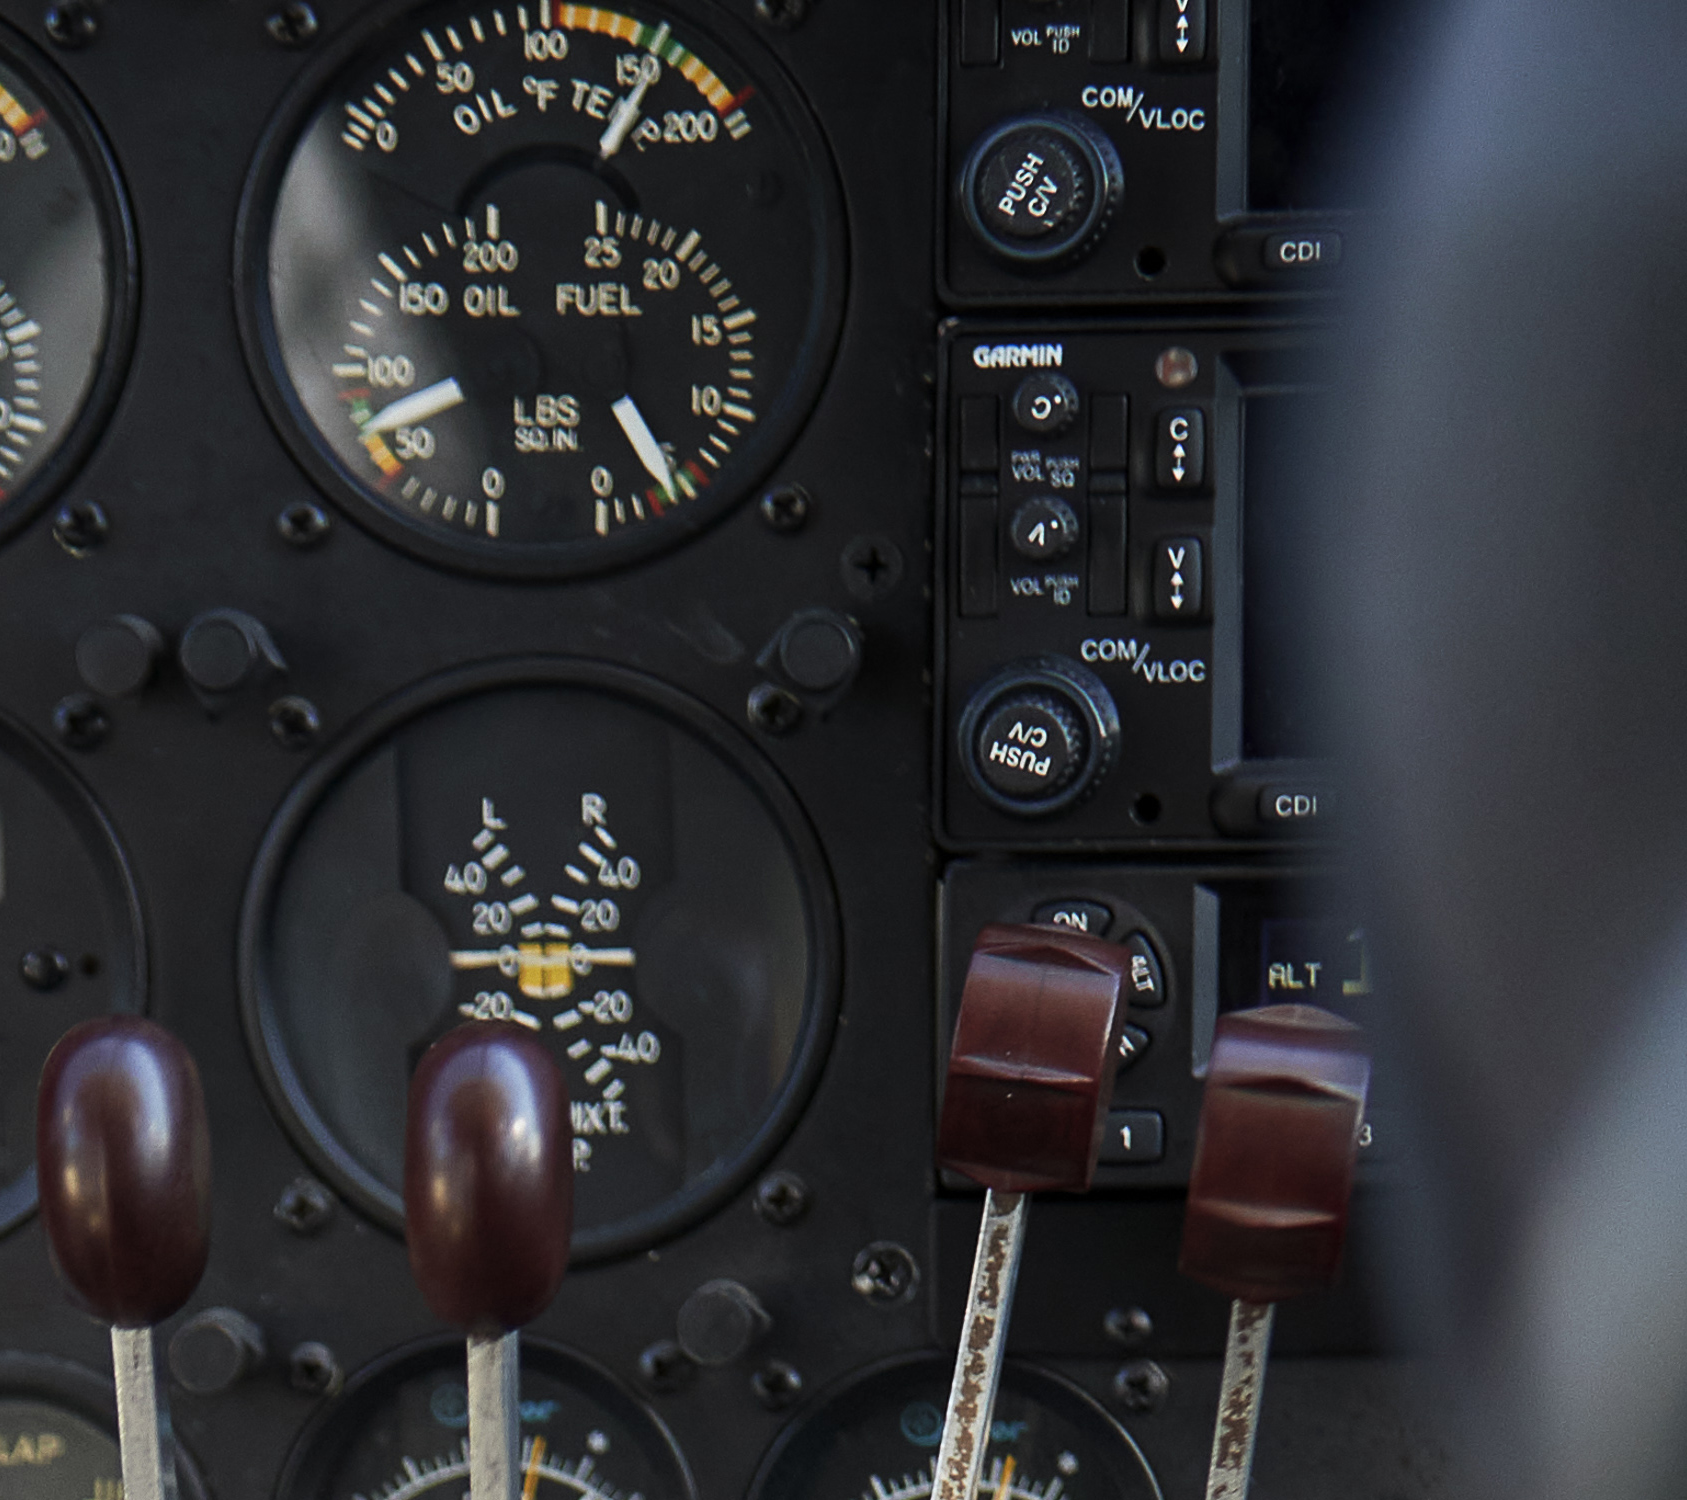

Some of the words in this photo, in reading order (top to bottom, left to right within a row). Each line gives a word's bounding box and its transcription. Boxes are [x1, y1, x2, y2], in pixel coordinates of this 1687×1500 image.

[524, 30, 568, 60] 100
[1012, 29, 1042, 46] VOL
[1046, 24, 1080, 38] PUSH
[1053, 39, 1069, 54] ID
[663, 111, 718, 143] 200
[998, 153, 1044, 216] PUSH
[1027, 176, 1058, 218] C/V
[463, 240, 518, 273] 200
[584, 237, 621, 269] 25
[1280, 240, 1321, 263] CDI
[643, 260, 680, 290] 20
[399, 283, 448, 315] 150
[463, 286, 521, 317] OIL
[556, 284, 641, 316] FUEL
[692, 316, 723, 347] 15
[973, 344, 1063, 369] GARMIN
[513, 395, 580, 427] LBS
[691, 385, 722, 415] 10
[1170, 417, 1189, 441] C
[1167, 547, 1185, 569] V
[1008, 722, 1048, 749] C/V
[989, 740, 1051, 777] PUSH
[482, 797, 507, 829] L
[582, 792, 607, 826] R
[1275, 795, 1317, 818] CDI
[598, 856, 641, 890] 40
[580, 899, 620, 934] 20
[1130, 953, 1154, 994] ALT
[1268, 961, 1323, 989] ALT
